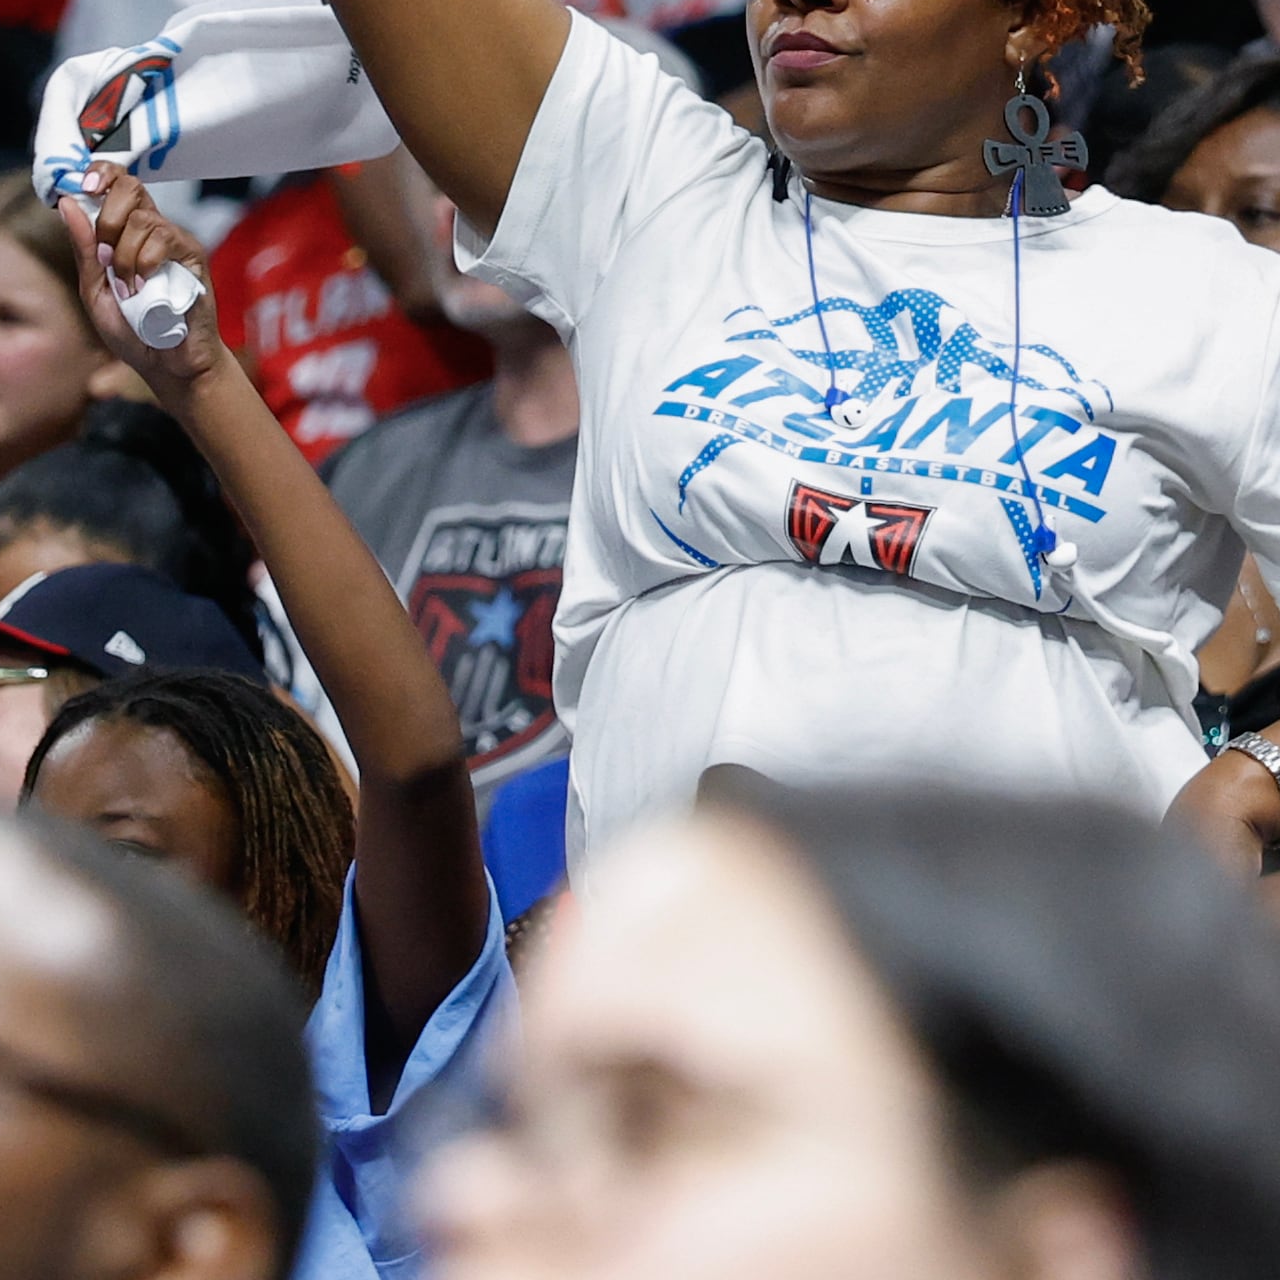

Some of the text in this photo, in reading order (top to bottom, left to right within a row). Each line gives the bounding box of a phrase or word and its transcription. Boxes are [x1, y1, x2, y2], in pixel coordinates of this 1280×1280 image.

[662, 354, 1117, 497] ATLANTA
[683, 404, 1071, 511] DREAM BASKETBALL
